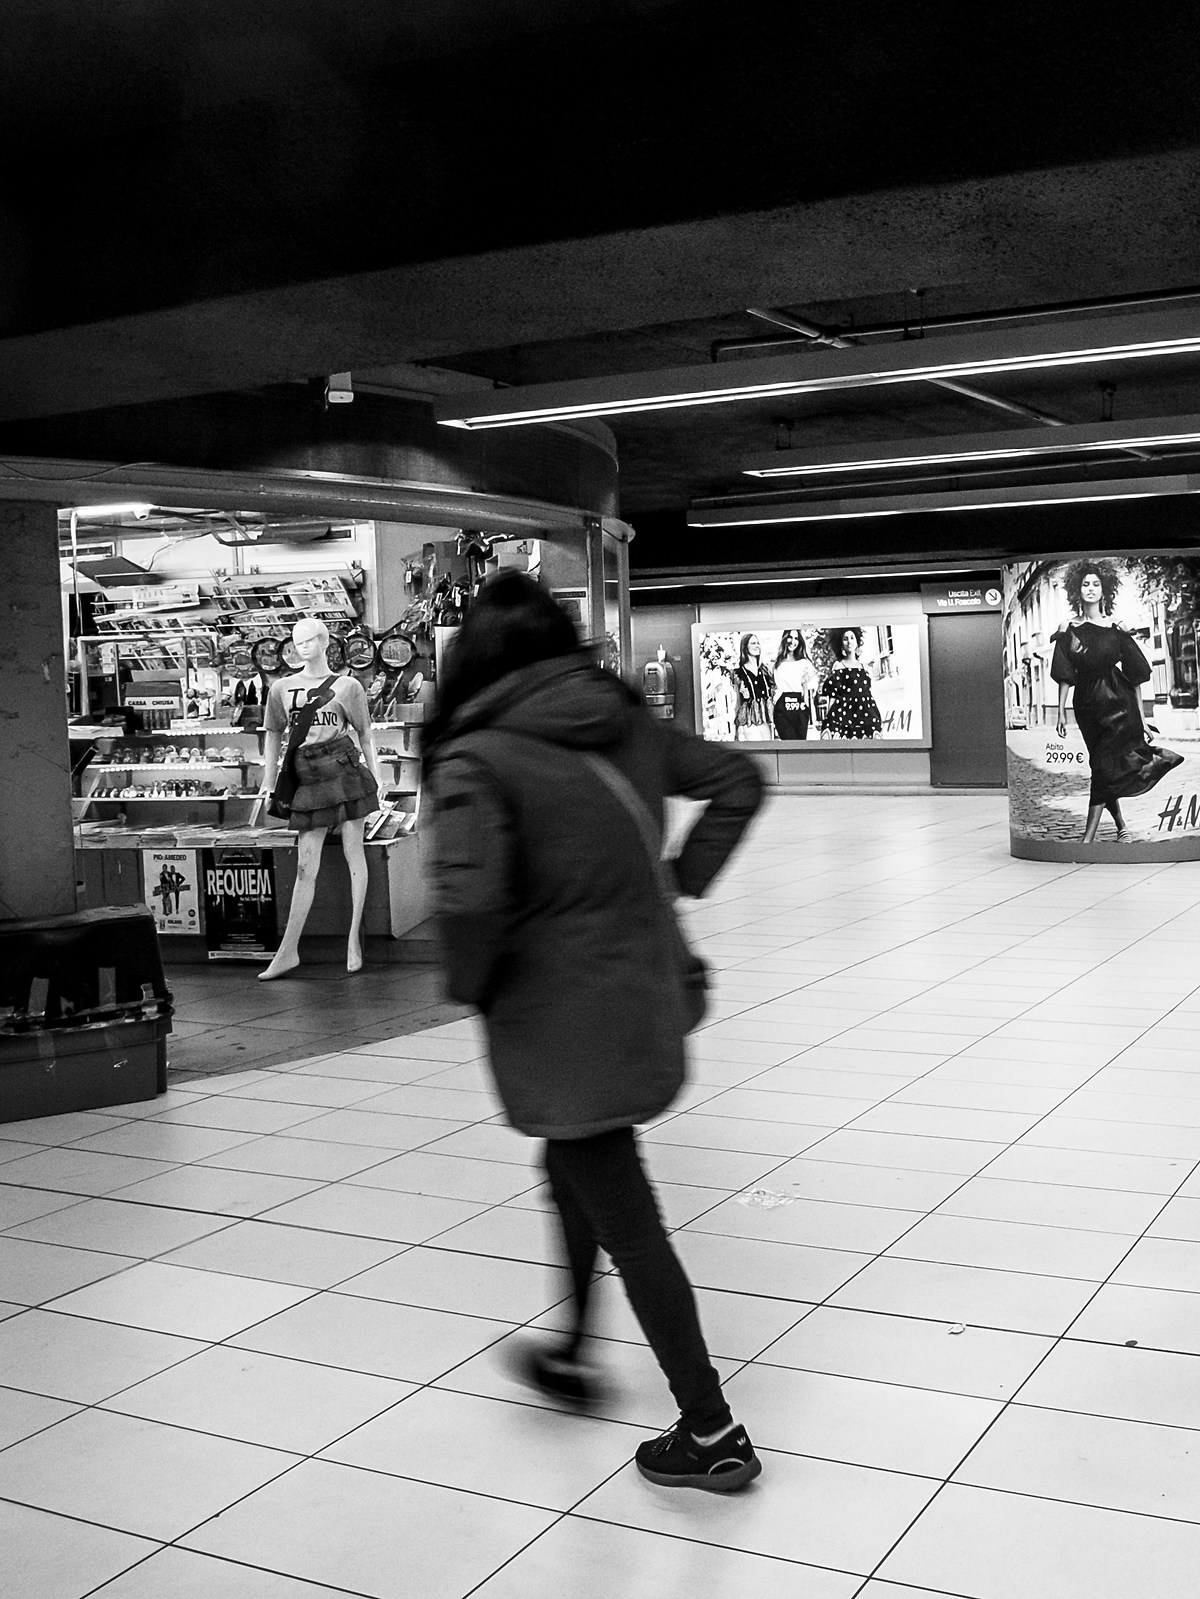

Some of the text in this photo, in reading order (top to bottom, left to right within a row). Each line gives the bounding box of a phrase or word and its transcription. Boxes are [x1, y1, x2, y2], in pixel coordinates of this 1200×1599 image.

[948, 590, 969, 598] Uscita
[785, 702, 799, 711] 9.99
[288, 711, 338, 727] MANO
[882, 709, 913, 732] H&M
[1045, 742, 1064, 751] Abito
[1046, 752, 1085, 763] 29.99 €
[206, 868, 272, 898] REQUIEM
